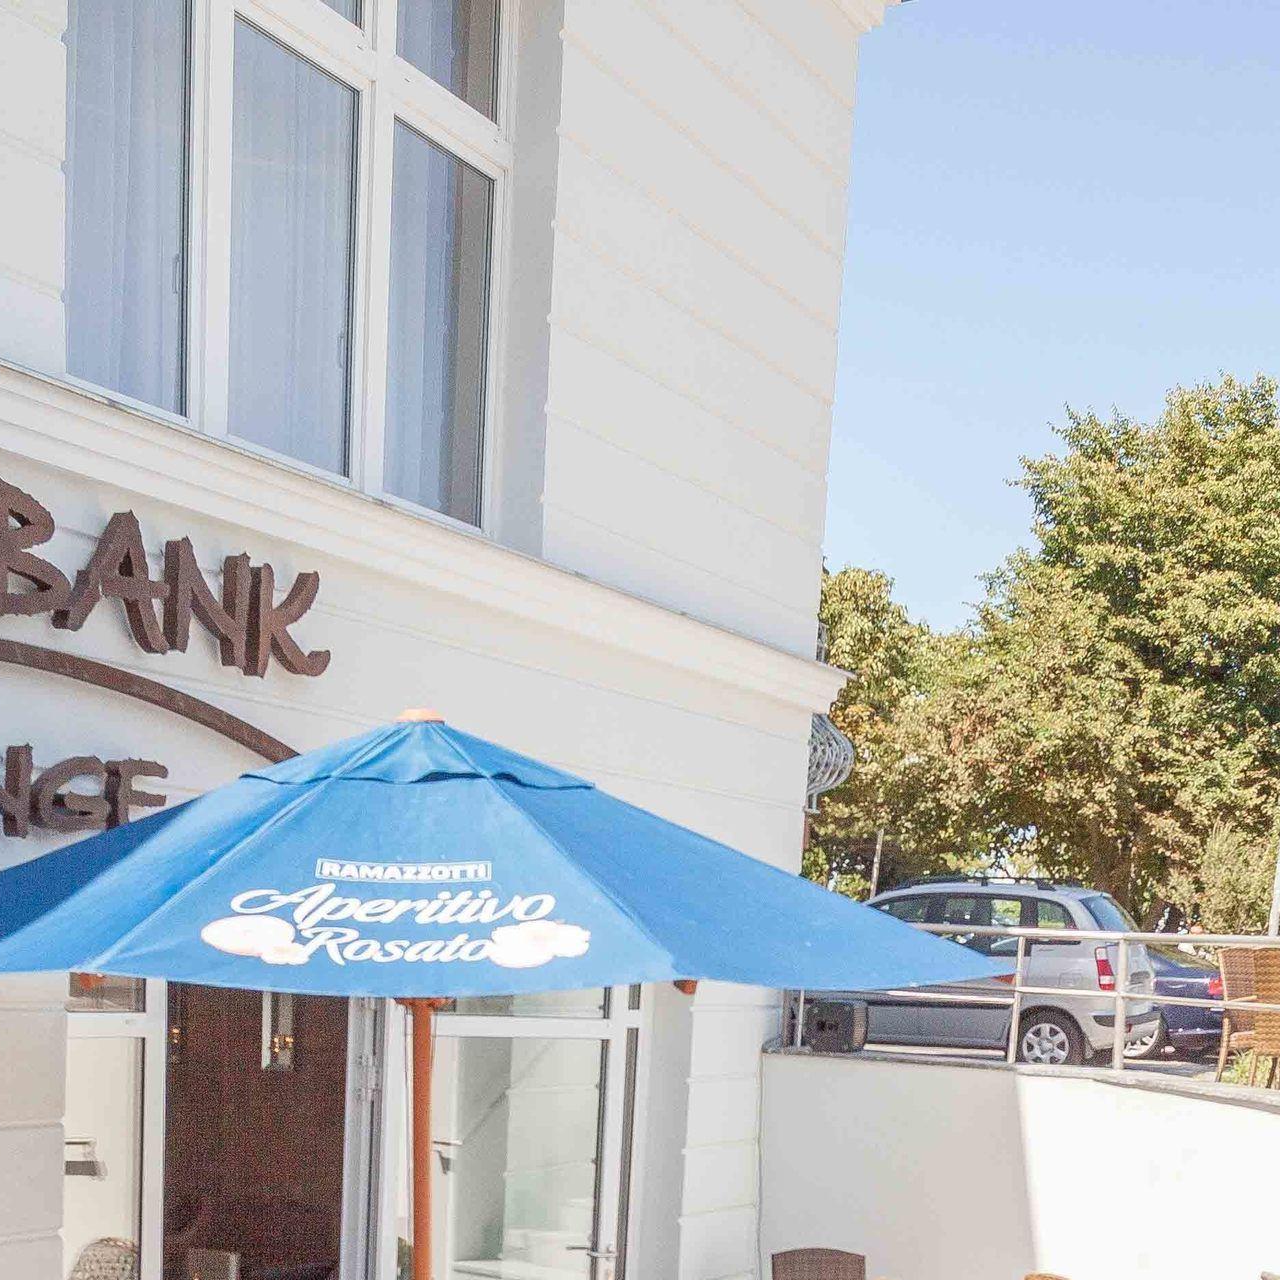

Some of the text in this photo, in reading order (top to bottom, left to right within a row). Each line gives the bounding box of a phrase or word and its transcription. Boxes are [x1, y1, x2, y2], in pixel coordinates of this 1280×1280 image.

[321, 861, 487, 881] RAMAZZOTTI
[231, 883, 556, 930] Aperitivo
[300, 926, 489, 966] Rosato
